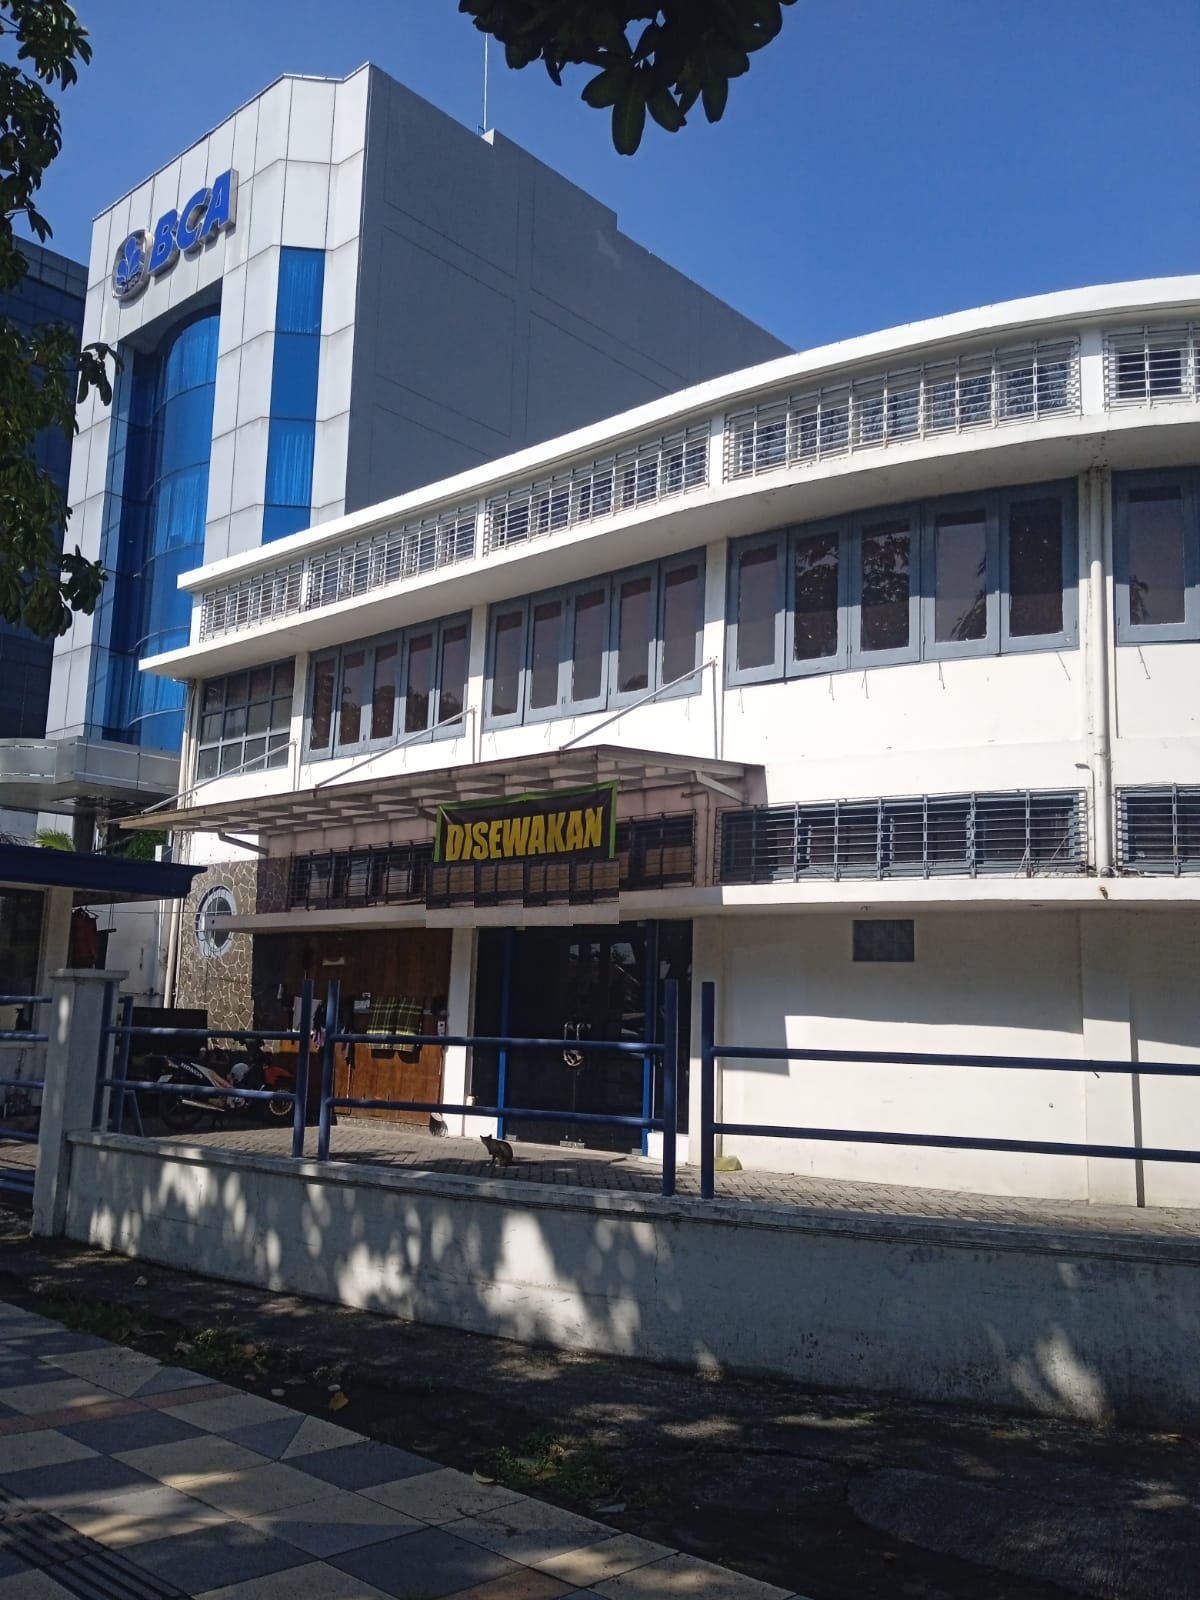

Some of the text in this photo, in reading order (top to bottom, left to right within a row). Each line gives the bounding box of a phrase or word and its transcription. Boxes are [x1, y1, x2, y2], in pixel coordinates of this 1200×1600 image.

[148, 168, 233, 272] BCA
[445, 806, 604, 862] DISEWAKAN
[180, 1062, 203, 1079] HONDA
